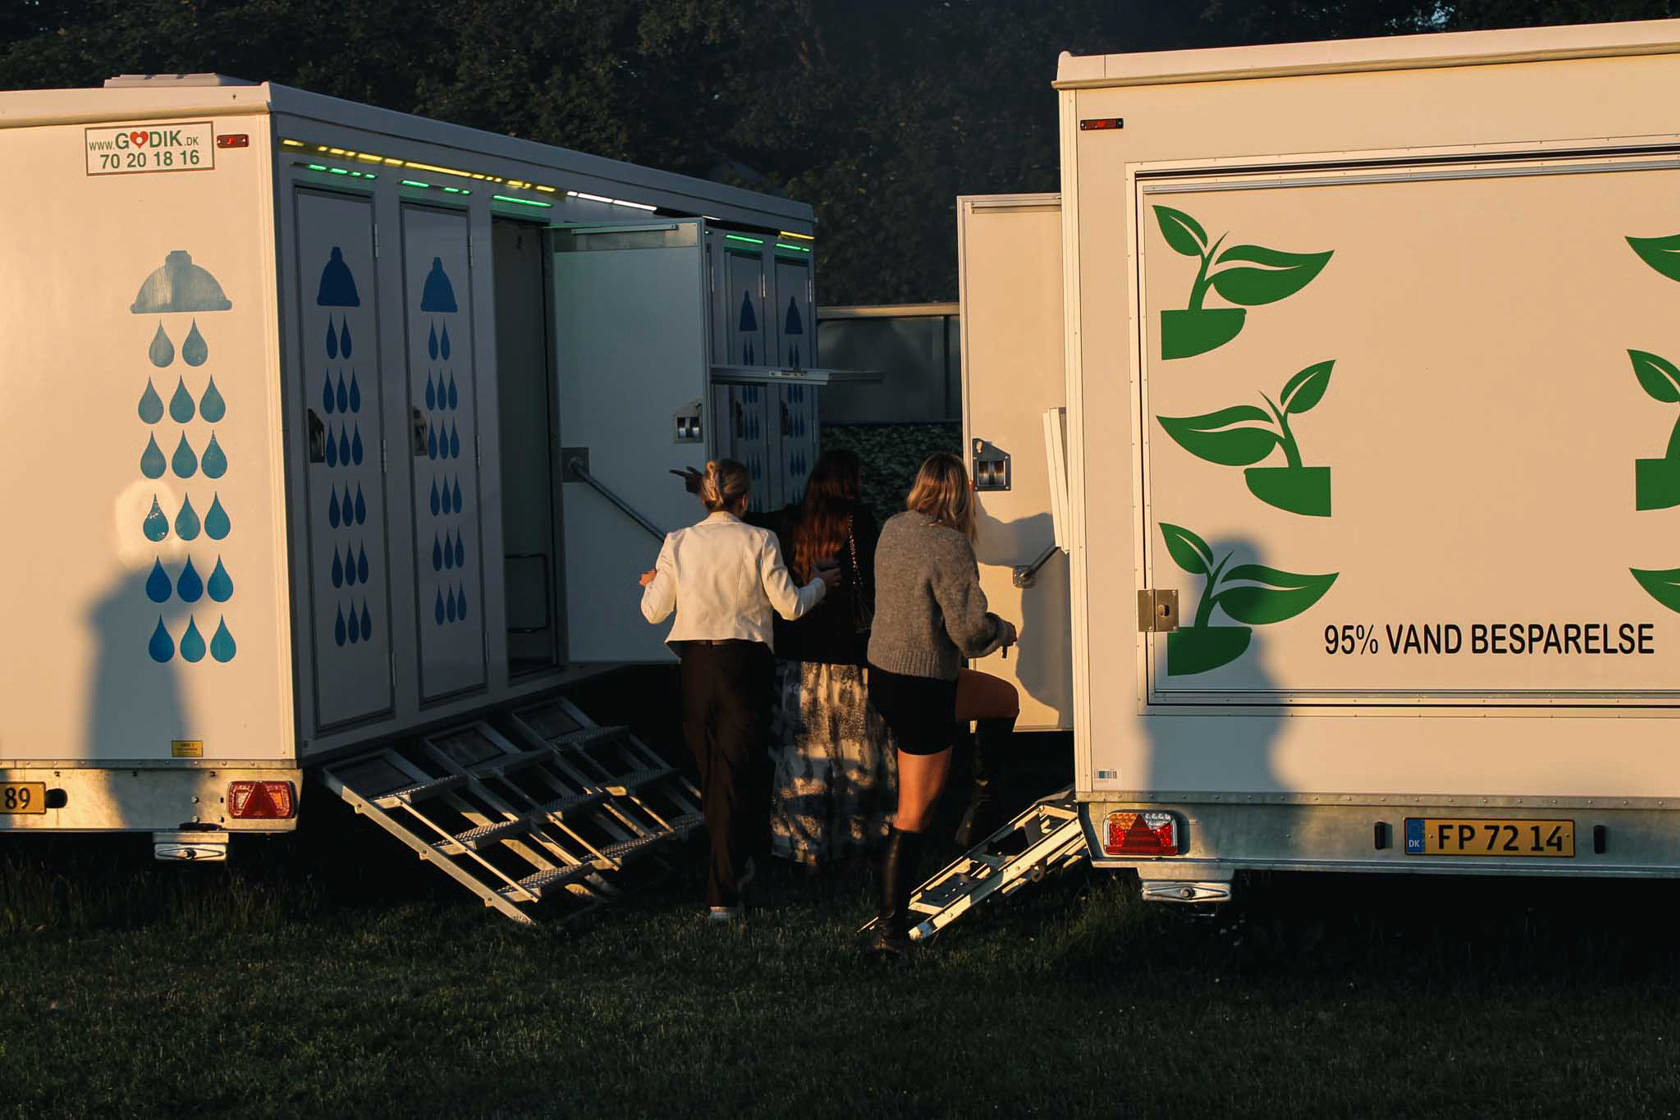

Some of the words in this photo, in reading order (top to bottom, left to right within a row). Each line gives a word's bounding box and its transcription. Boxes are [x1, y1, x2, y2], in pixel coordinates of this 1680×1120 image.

[100, 153, 121, 169] 70
[126, 152, 147, 168] 20
[153, 150, 173, 166] 18
[180, 149, 200, 165] 16
[1324, 624, 1379, 655] 95%
[1386, 623, 1462, 655] VAND
[1471, 623, 1655, 655] BESPARELSE
[5, 787, 31, 810] 89
[1408, 839, 1420, 848] DK
[1438, 824, 1476, 850] FP
[1484, 825, 1519, 851] 72
[1530, 825, 1562, 852] 14
